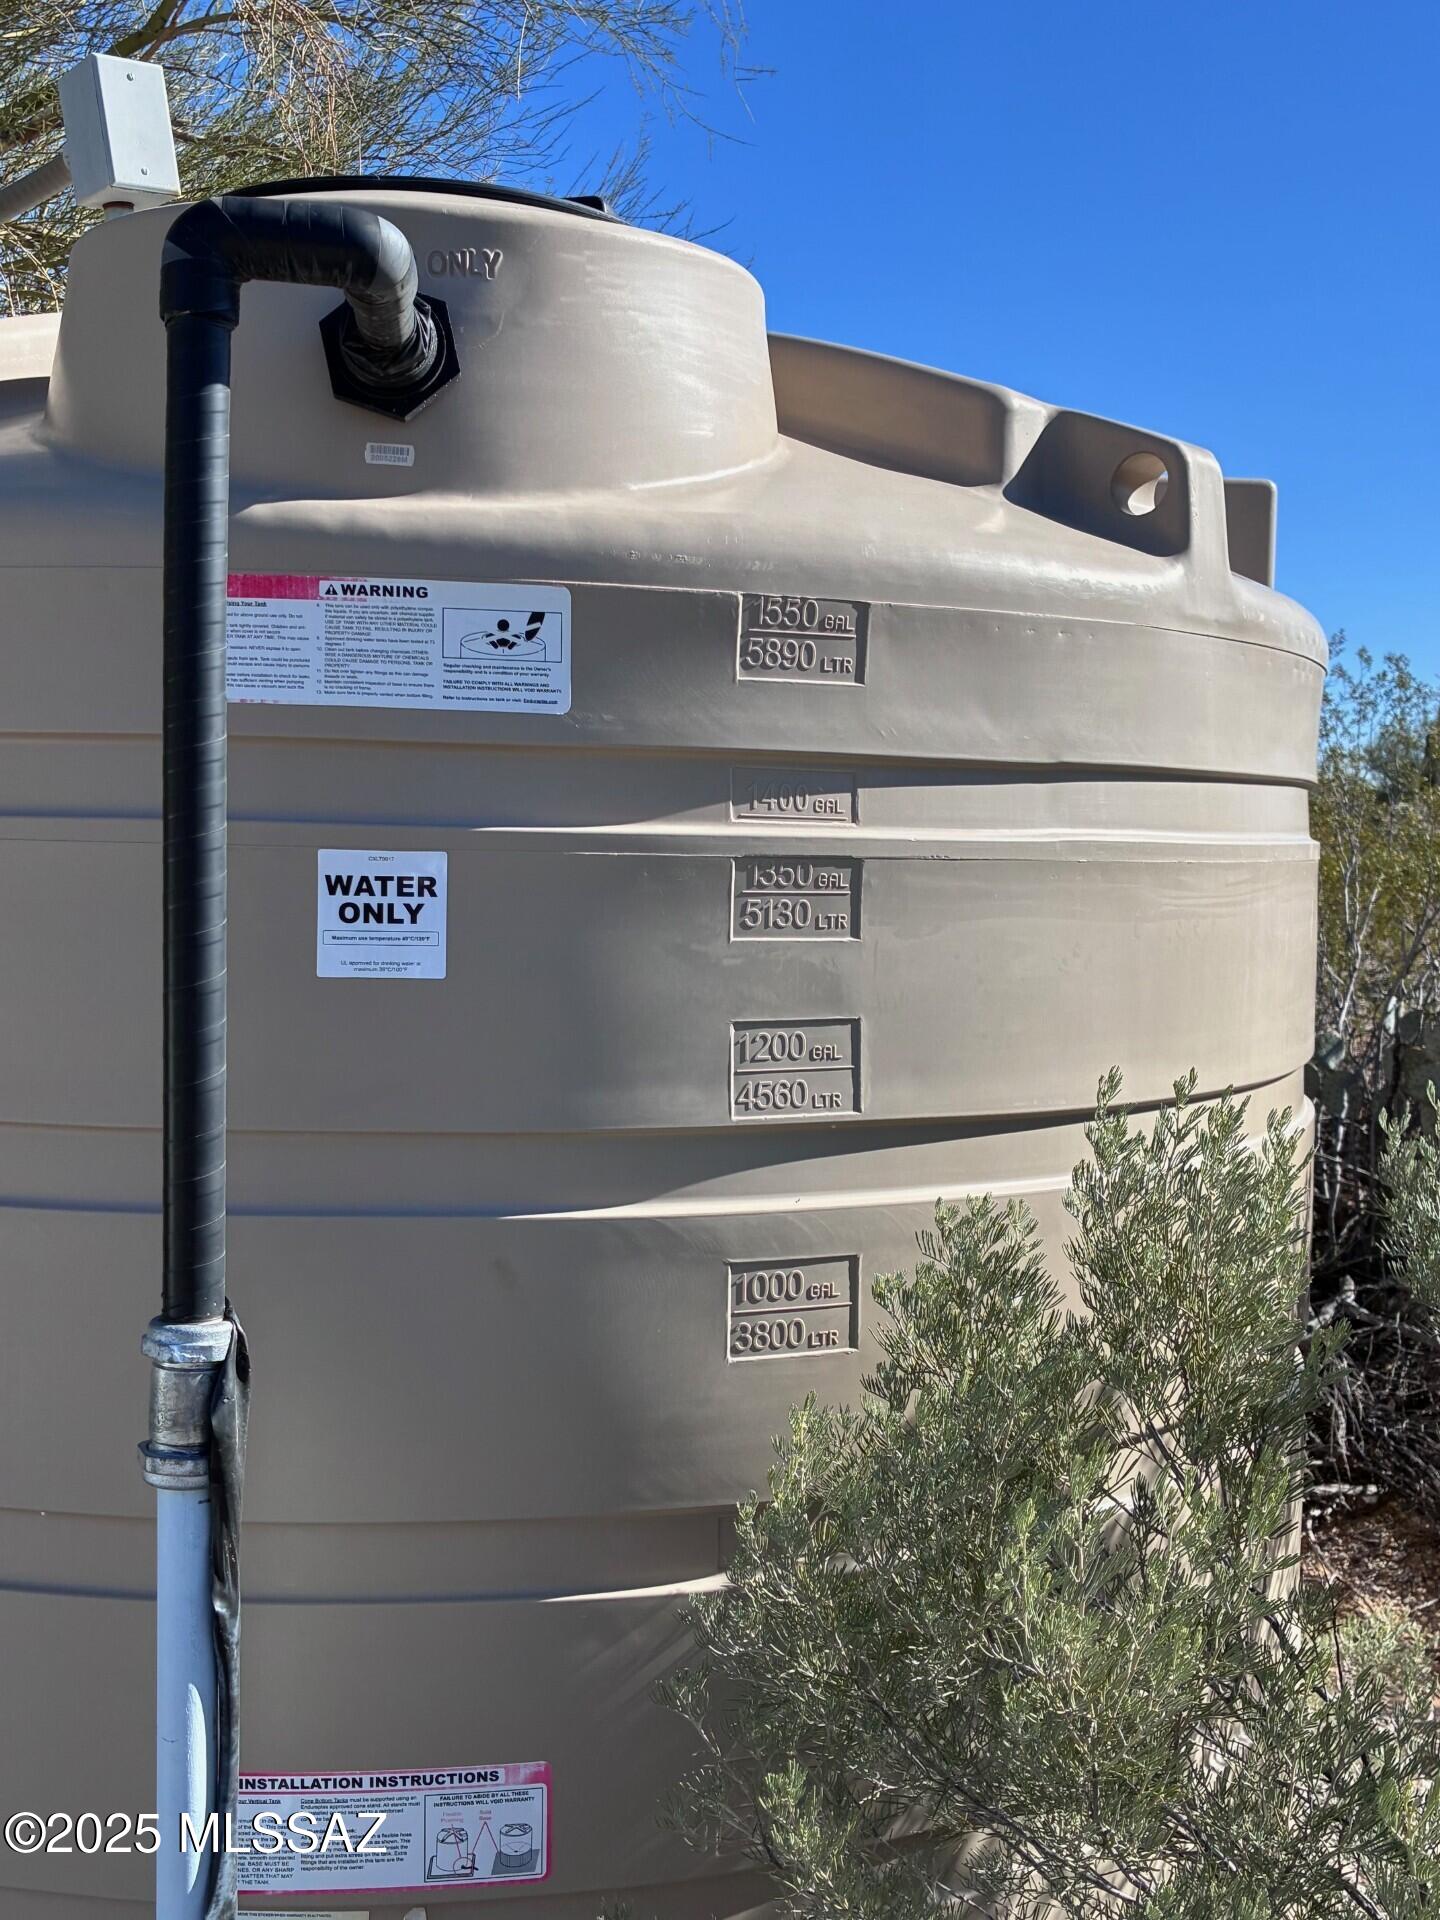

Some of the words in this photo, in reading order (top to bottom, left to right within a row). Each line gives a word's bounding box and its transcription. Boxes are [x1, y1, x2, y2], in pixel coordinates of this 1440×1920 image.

[427, 248, 504, 280] ONLY
[341, 584, 428, 598] WARNING
[753, 596, 818, 628] 1550
[824, 614, 856, 631] GAL
[744, 638, 817, 669] 5890
[823, 656, 853, 673] LTR
[748, 783, 810, 811] 1400
[814, 798, 846, 814] GAL
[325, 874, 438, 898] WATER
[817, 872, 849, 888] GAL
[338, 902, 424, 924] ONLY
[743, 898, 812, 928] 5130
[817, 913, 848, 929] LTR
[734, 1031, 807, 1062] 1200
[812, 1044, 843, 1060] GAL
[736, 1079, 809, 1110] 4560
[812, 1092, 842, 1108] LTR
[733, 1270, 805, 1302] 1000
[810, 1282, 841, 1298] GAL
[734, 1318, 806, 1350] 3800
[810, 1329, 840, 1346] LTR
[239, 1777, 363, 1790] INSTALLATION
[370, 1770, 499, 1788] INSTRUCTIONS
